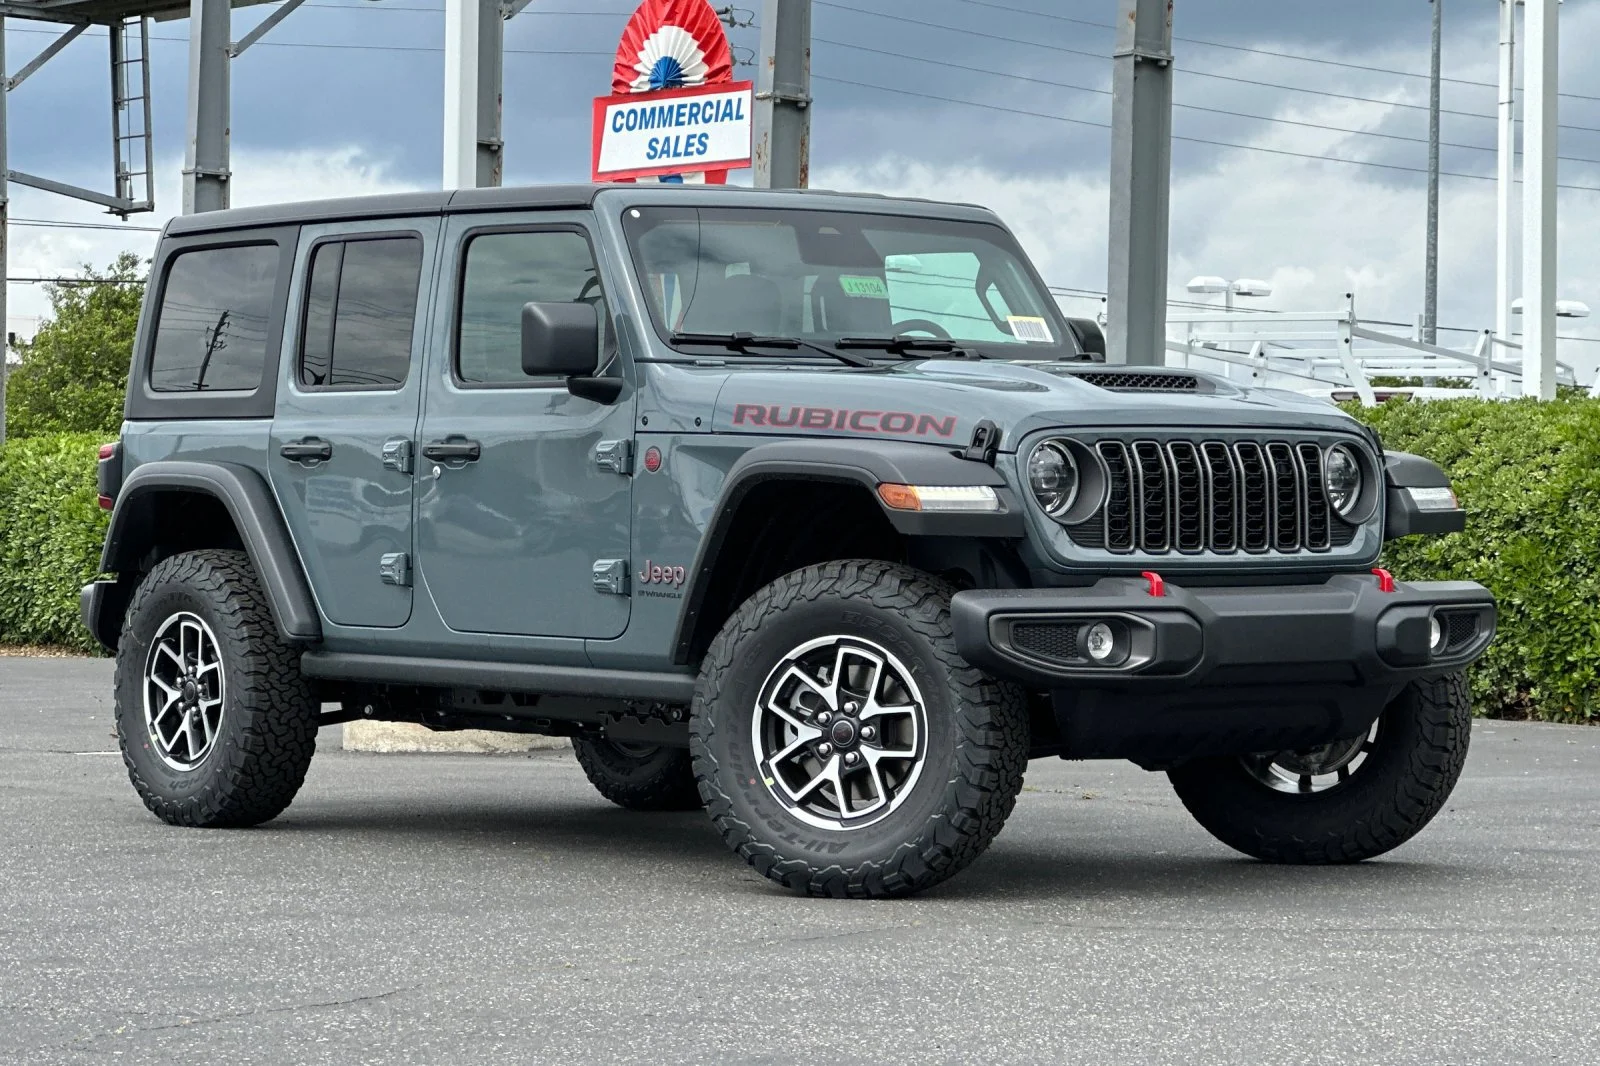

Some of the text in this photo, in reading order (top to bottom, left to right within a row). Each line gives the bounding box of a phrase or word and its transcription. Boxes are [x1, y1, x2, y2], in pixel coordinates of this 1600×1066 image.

[611, 98, 745, 134] COMMERCIAL
[646, 132, 710, 161] SALES
[732, 403, 958, 437] RUBICON
[638, 559, 686, 590] Jeep
[645, 590, 683, 598] WRANGLE
